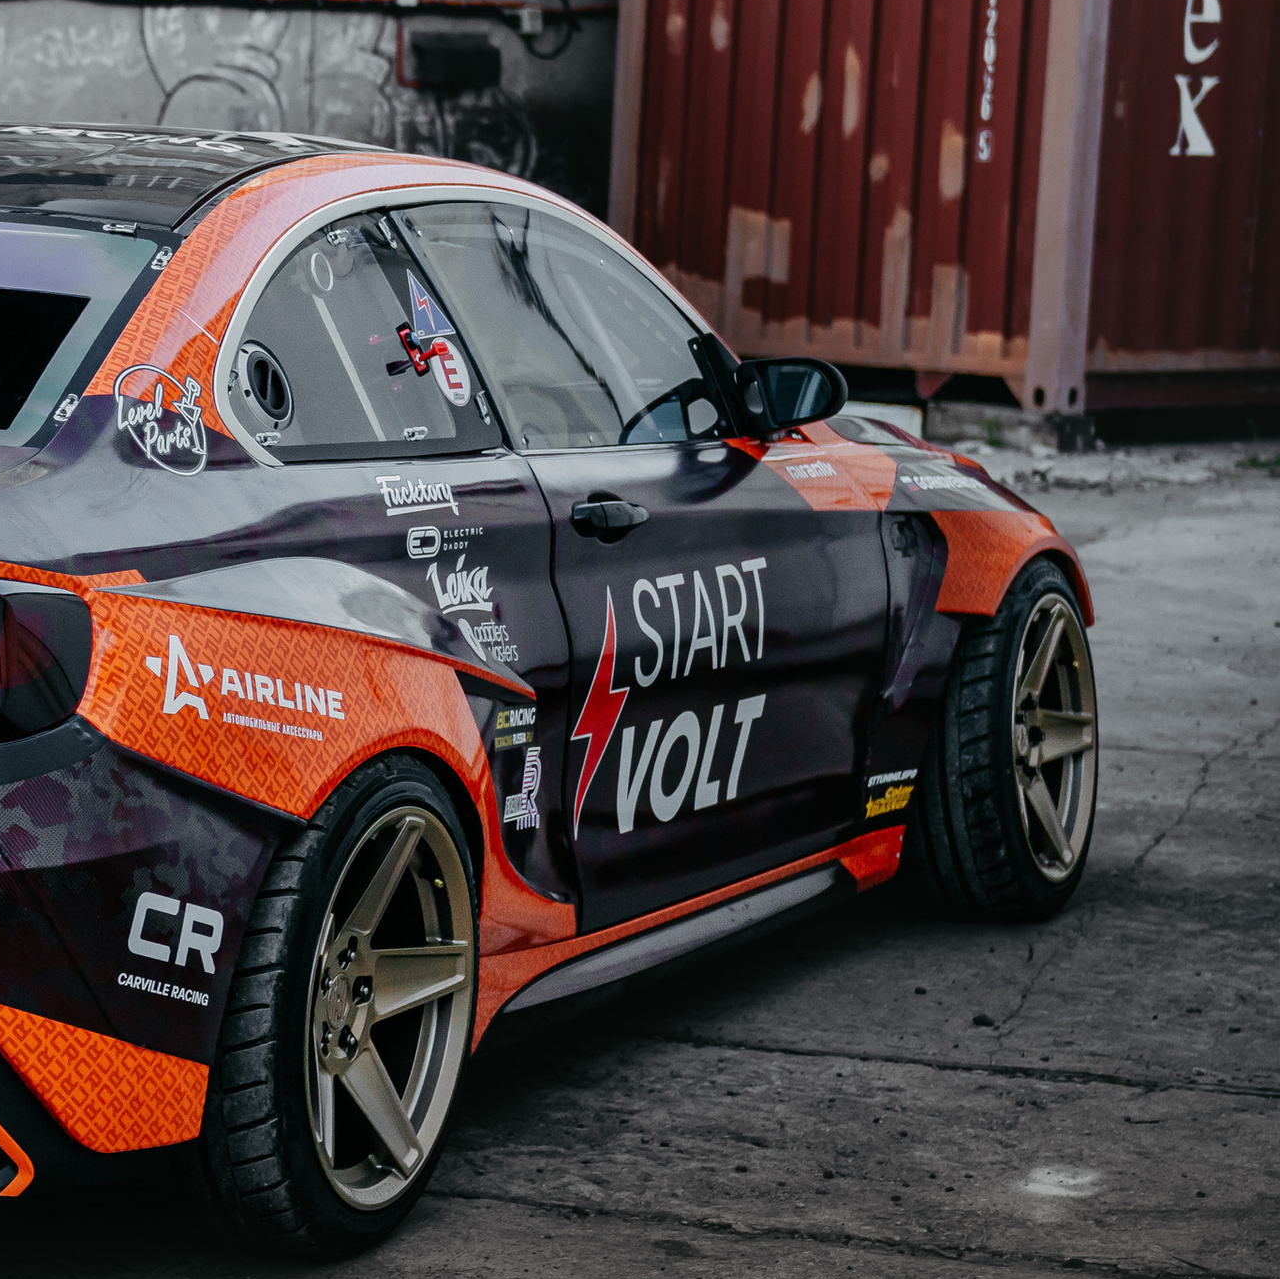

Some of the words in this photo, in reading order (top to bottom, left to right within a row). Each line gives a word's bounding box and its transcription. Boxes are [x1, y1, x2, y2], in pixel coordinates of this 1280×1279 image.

[0, 125, 245, 153] RACING
[117, 383, 163, 430] Level
[144, 421, 192, 459] Parts
[443, 527, 484, 539] ELECTRIC
[443, 541, 469, 551] DADDY
[631, 557, 768, 688] START
[221, 667, 346, 720] AIRLINE
[222, 712, 281, 734] АВТОМОБИЛЬНЫЕ
[281, 723, 323, 742] АКСЕССУАРЫ
[510, 707, 537, 727] RACING
[616, 694, 767, 835] VOLT
[127, 891, 224, 975] CR
[117, 972, 171, 997] CARVILLE
[170, 984, 210, 1007] RACING
